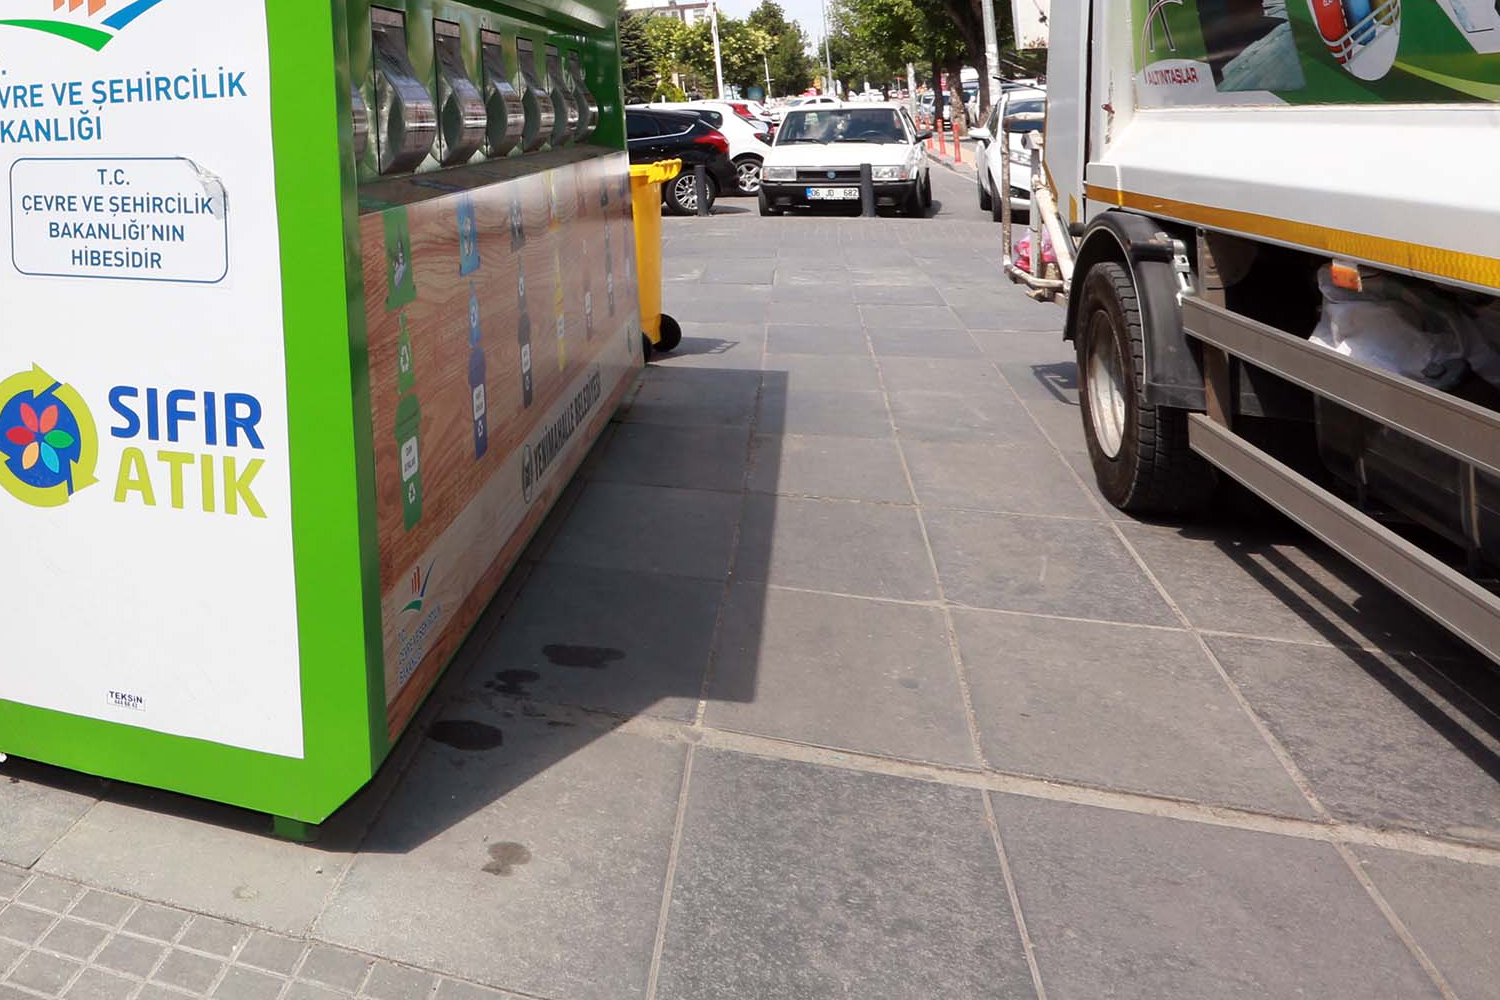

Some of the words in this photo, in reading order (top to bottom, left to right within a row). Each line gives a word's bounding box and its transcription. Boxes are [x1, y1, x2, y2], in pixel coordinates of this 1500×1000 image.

[52, 81, 83, 106] VE
[91, 66, 247, 111] ŞEHİRCİLİK
[97, 169, 130, 185] T.C.
[22, 195, 77, 215] ÇEVRE
[81, 196, 104, 212] VE
[109, 192, 214, 217] ŞEHİRCİLİK
[50, 219, 185, 241] BAKANLIĞI'NIN
[72, 246, 162, 269] HİBESİDİR
[108, 385, 265, 449] SIFIR
[114, 446, 268, 519] ATIK
